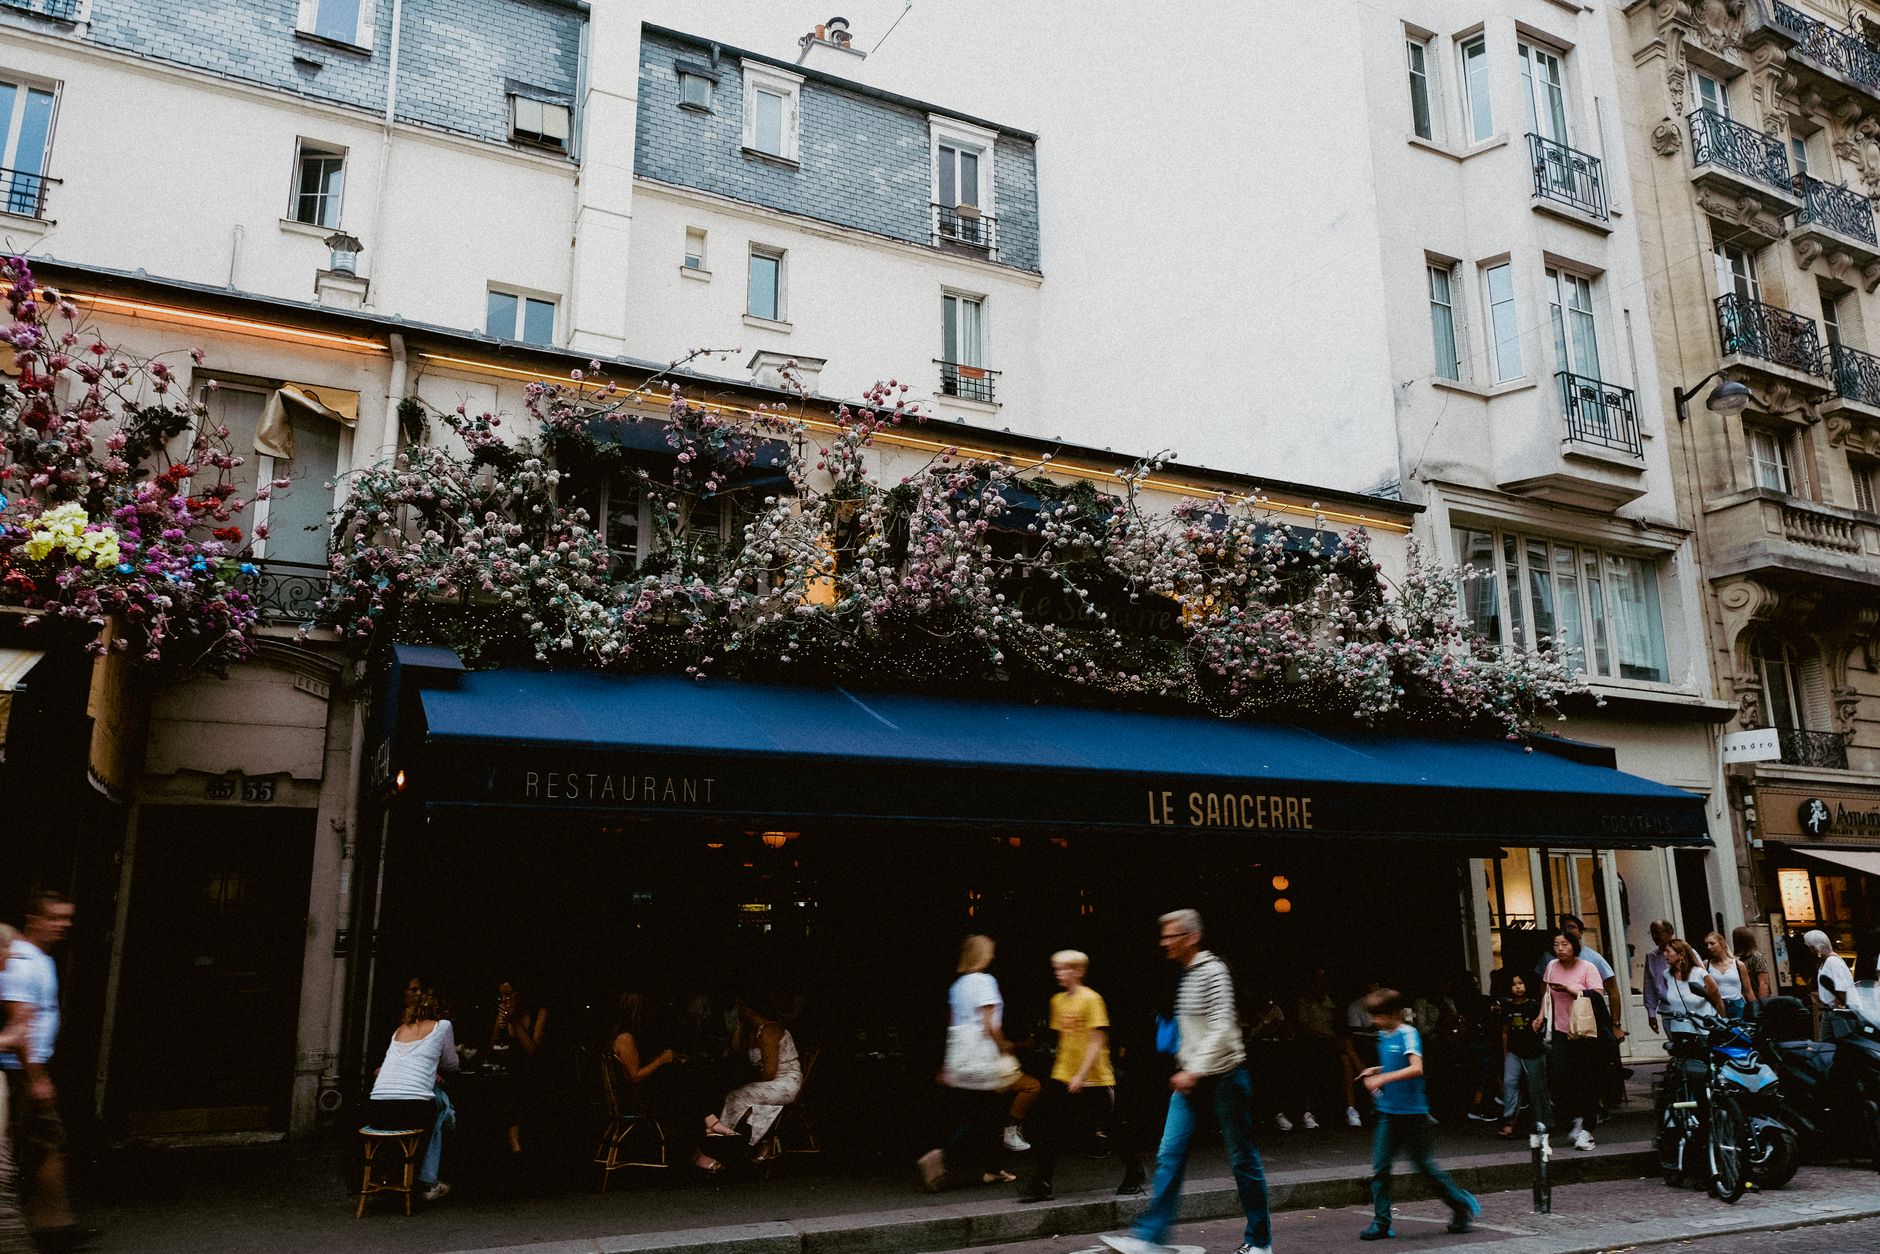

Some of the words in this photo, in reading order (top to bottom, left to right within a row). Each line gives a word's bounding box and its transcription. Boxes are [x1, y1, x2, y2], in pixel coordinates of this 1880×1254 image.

[1724, 742, 1773, 752] sandro
[526, 771, 716, 803] RESTAURANT
[1148, 791, 1175, 825] LE
[1187, 791, 1313, 830] SANCERRE
